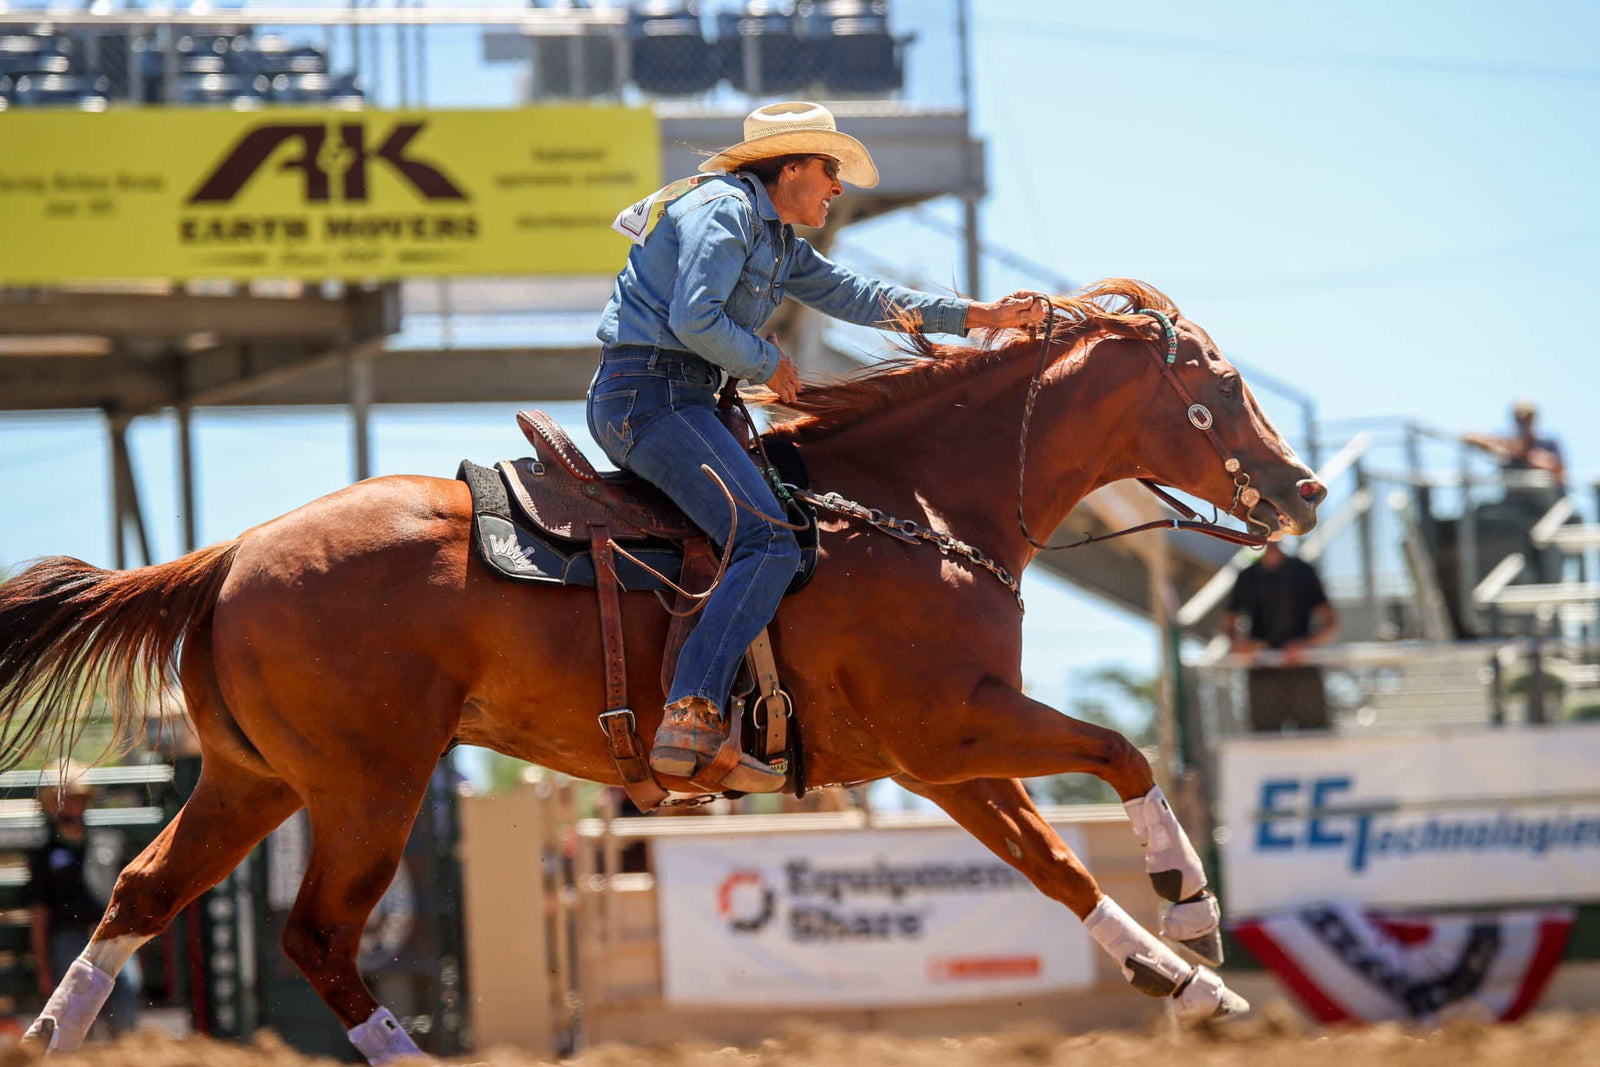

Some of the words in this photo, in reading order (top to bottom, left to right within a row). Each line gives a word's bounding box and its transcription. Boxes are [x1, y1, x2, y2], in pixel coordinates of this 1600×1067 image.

[180, 214, 308, 242] EARTH
[322, 213, 479, 240] MOVERS
[1346, 796, 1600, 872] Technologie
[784, 856, 1030, 900] Equipmen
[786, 904, 924, 945] Share
